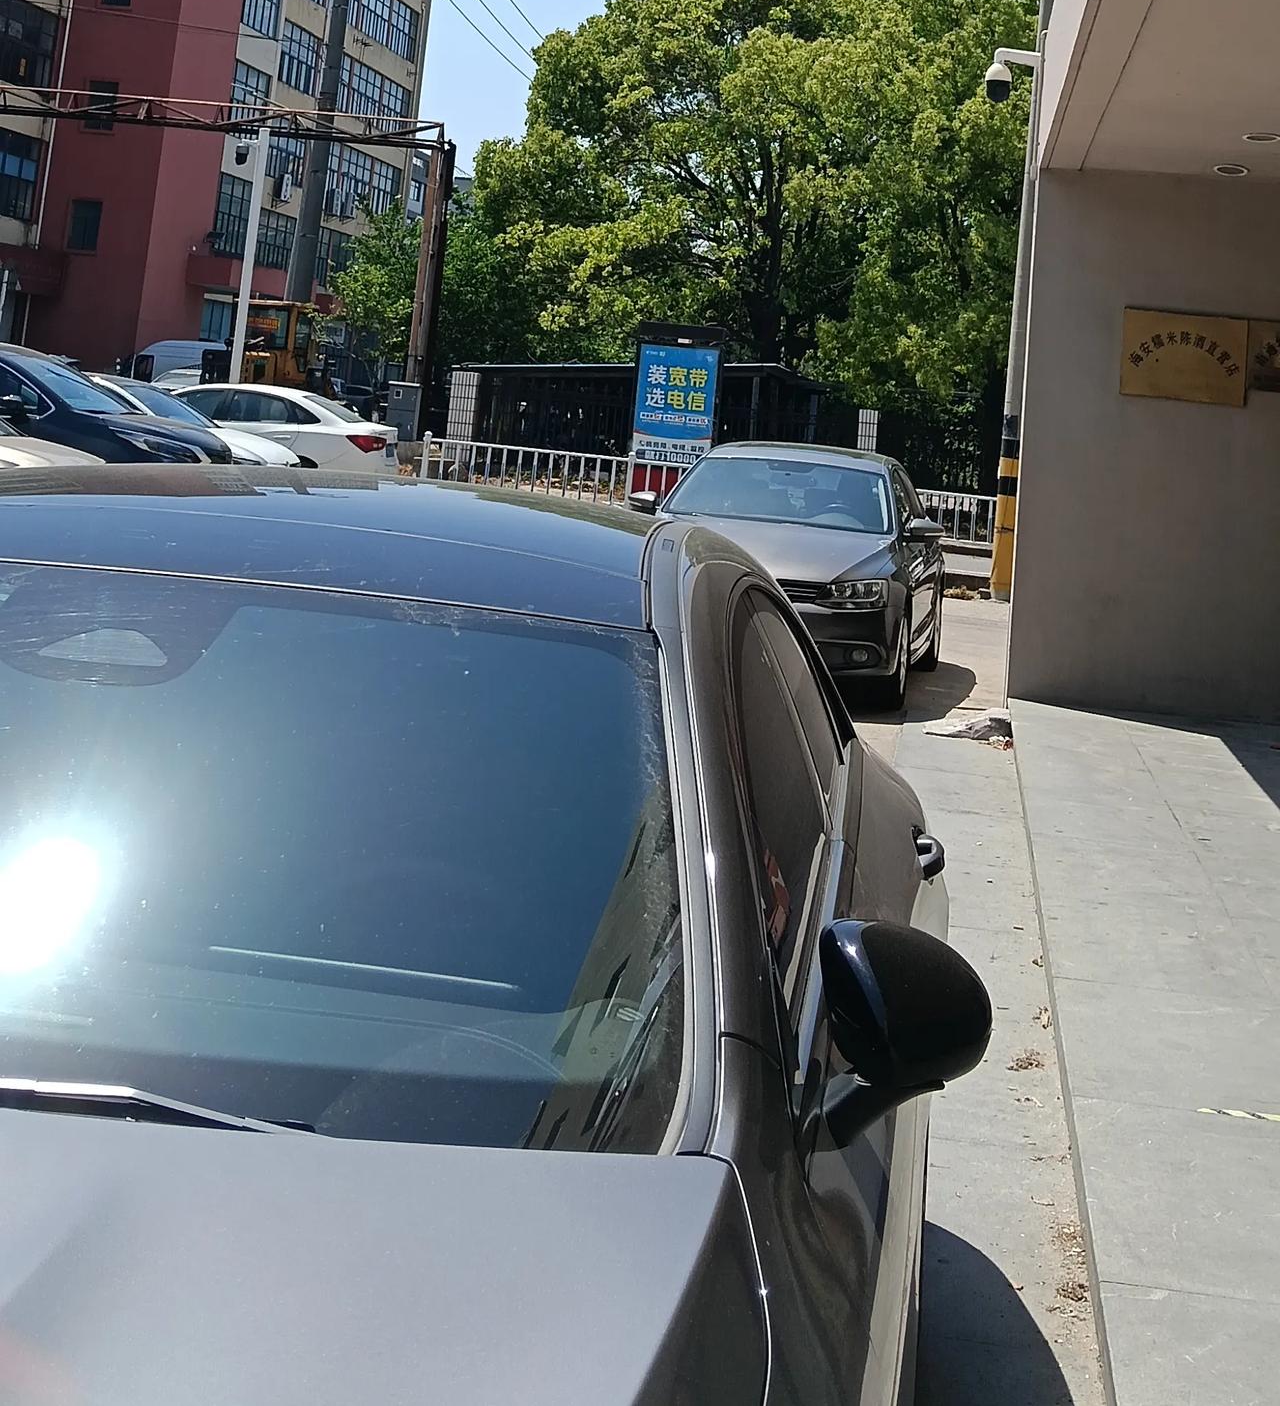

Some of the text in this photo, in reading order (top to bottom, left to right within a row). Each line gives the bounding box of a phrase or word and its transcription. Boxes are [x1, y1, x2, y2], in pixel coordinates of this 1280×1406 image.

[647, 364, 708, 388] 装宽带
[645, 387, 706, 411] 选电信
